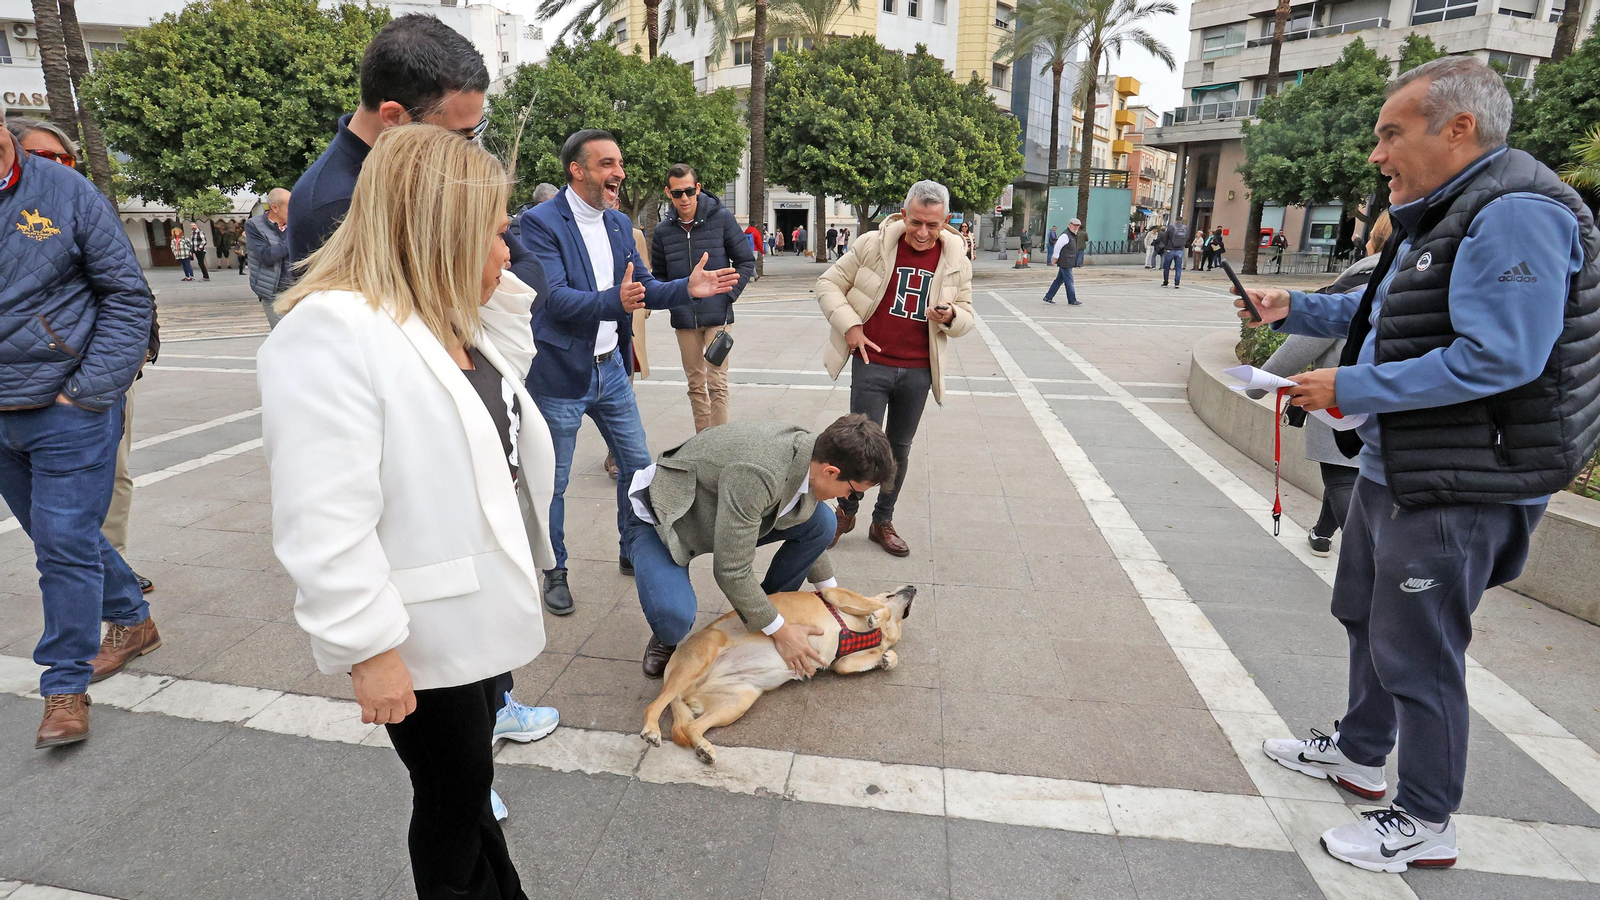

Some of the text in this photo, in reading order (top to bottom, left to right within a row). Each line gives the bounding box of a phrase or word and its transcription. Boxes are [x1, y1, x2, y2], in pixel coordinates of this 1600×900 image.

[4, 92, 49, 106] CAS
[1498, 274, 1538, 283] adidas
[889, 266, 935, 322] H
[1404, 577, 1435, 589] NIKE
